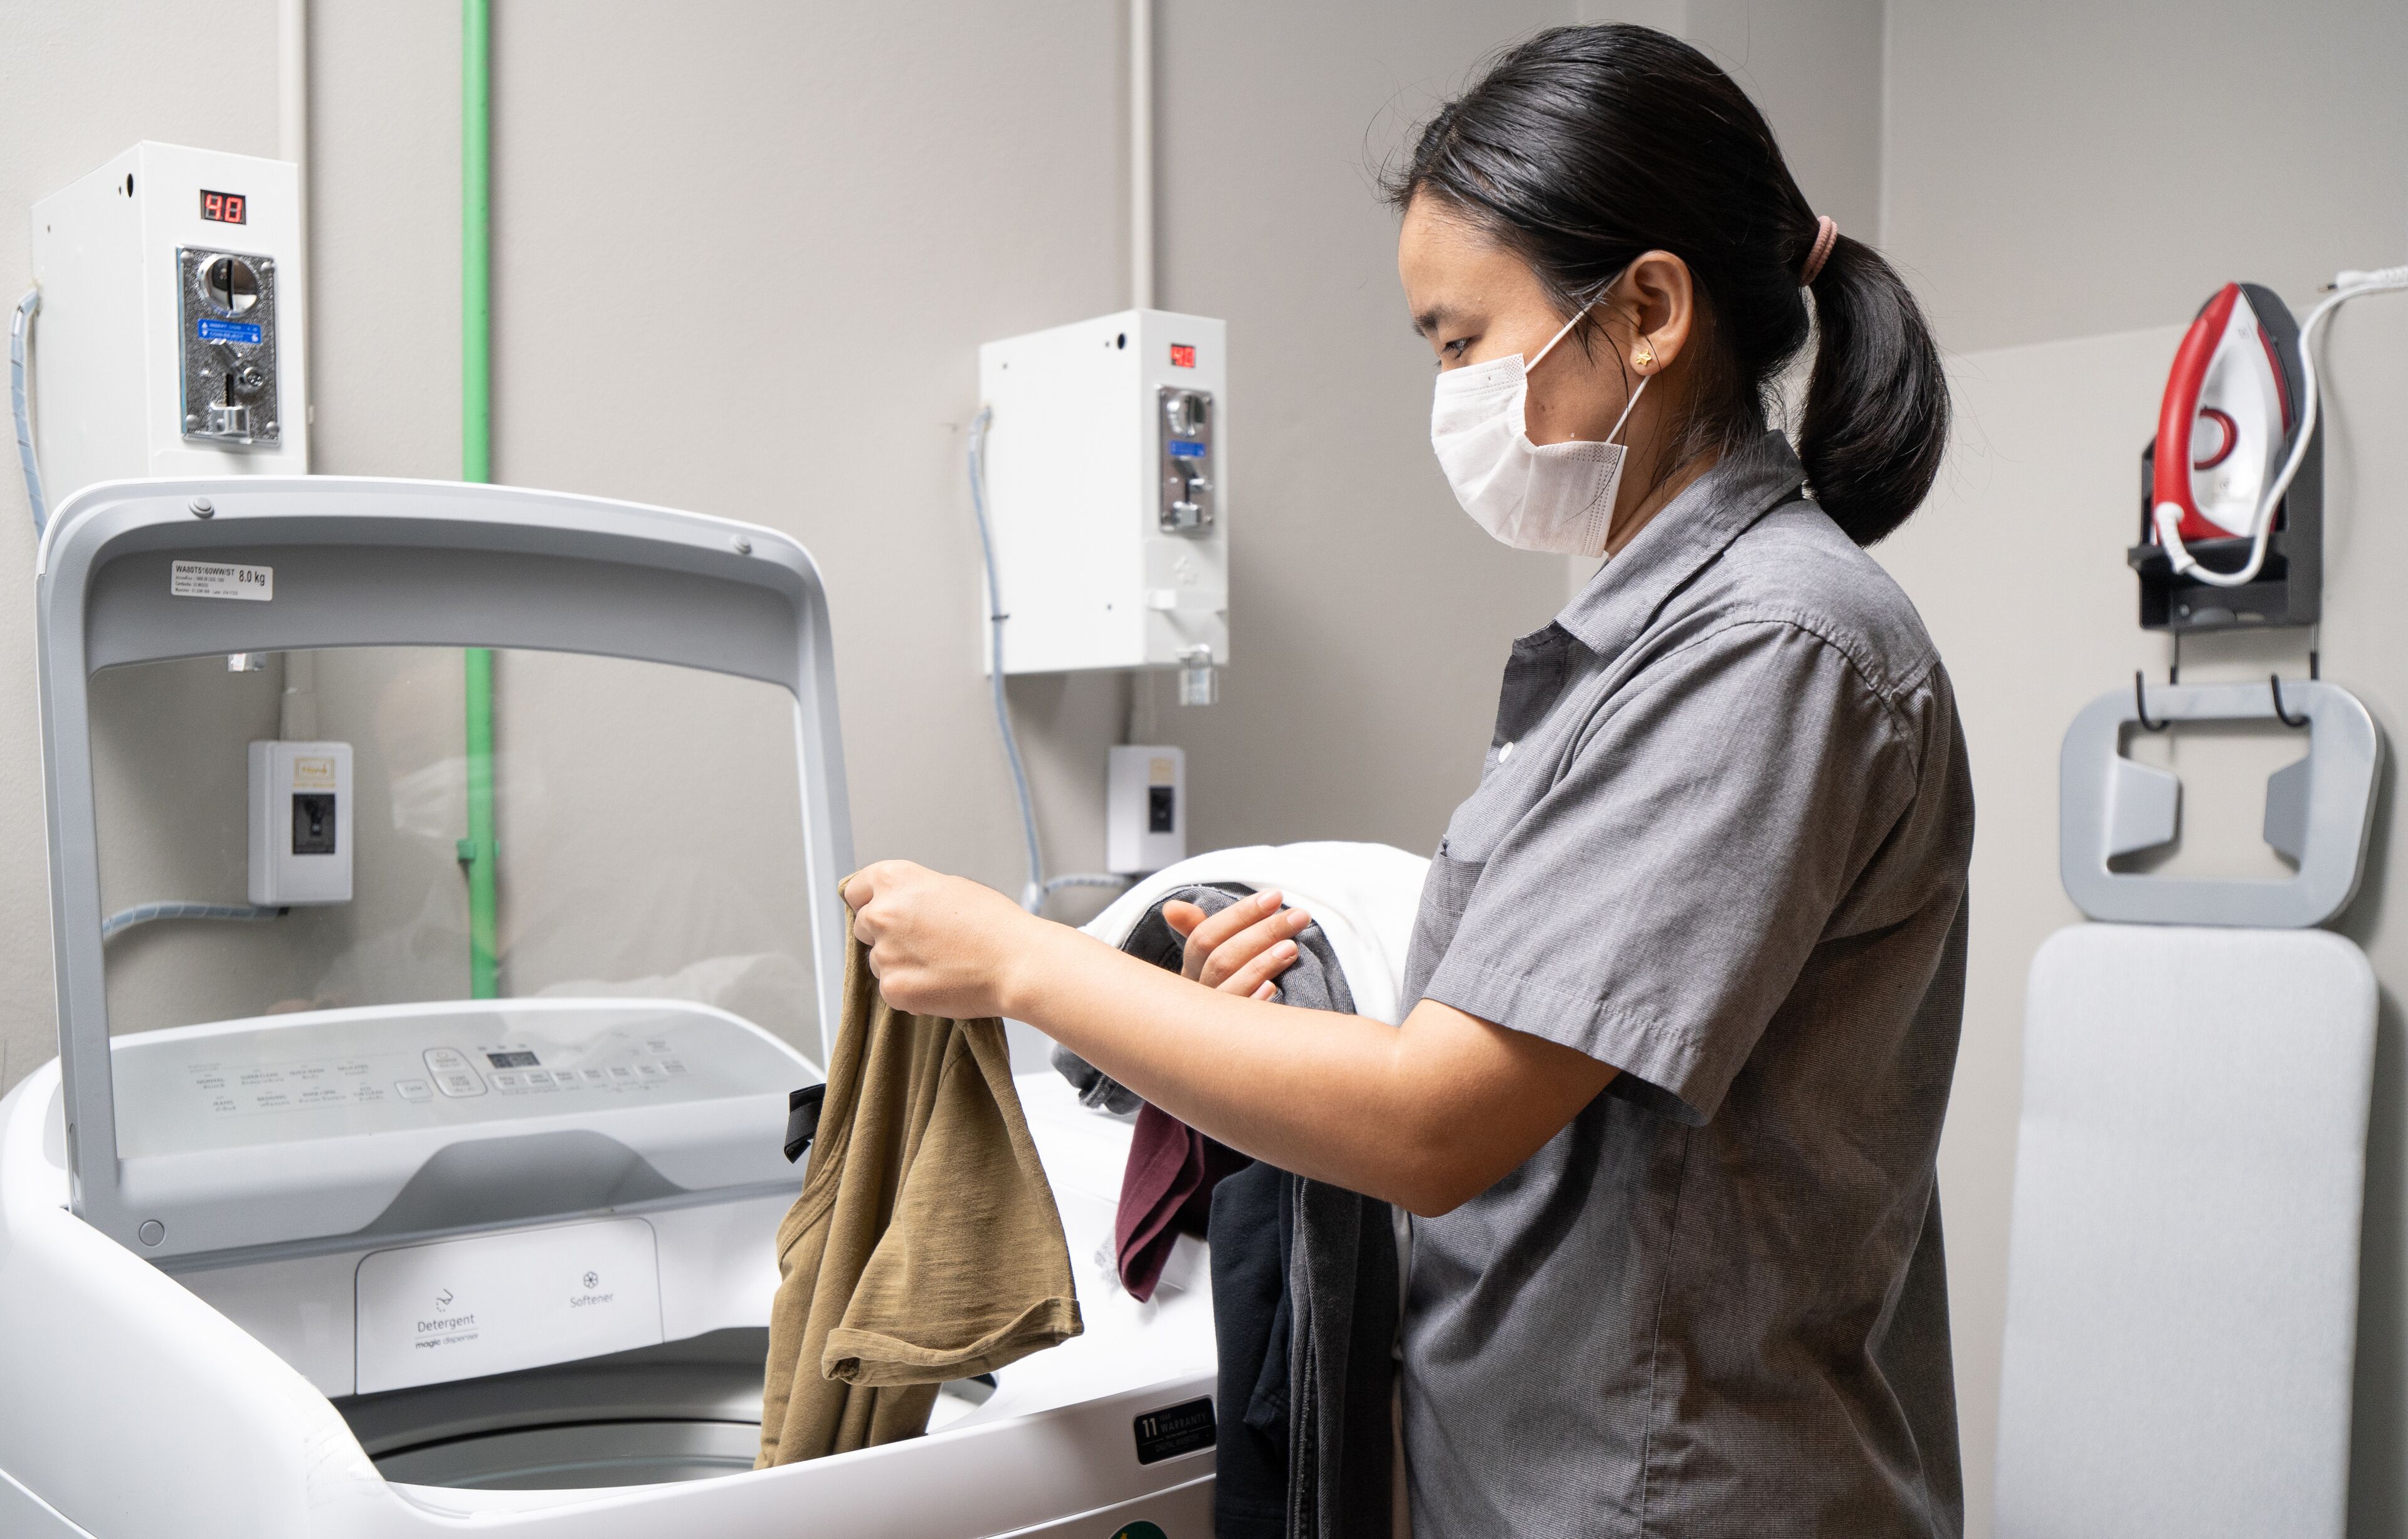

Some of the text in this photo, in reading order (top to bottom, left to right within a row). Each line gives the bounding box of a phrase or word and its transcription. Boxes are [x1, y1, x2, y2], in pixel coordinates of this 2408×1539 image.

[204, 194, 243, 223] 40
[239, 569, 251, 583] 8.0
[254, 571, 265, 586] kg
[570, 1292, 613, 1308] Softener
[418, 1314, 475, 1333] Detergent
[415, 1333, 478, 1350] magic dispenser
[1142, 1412, 1207, 1438] 11 WARRANTY
